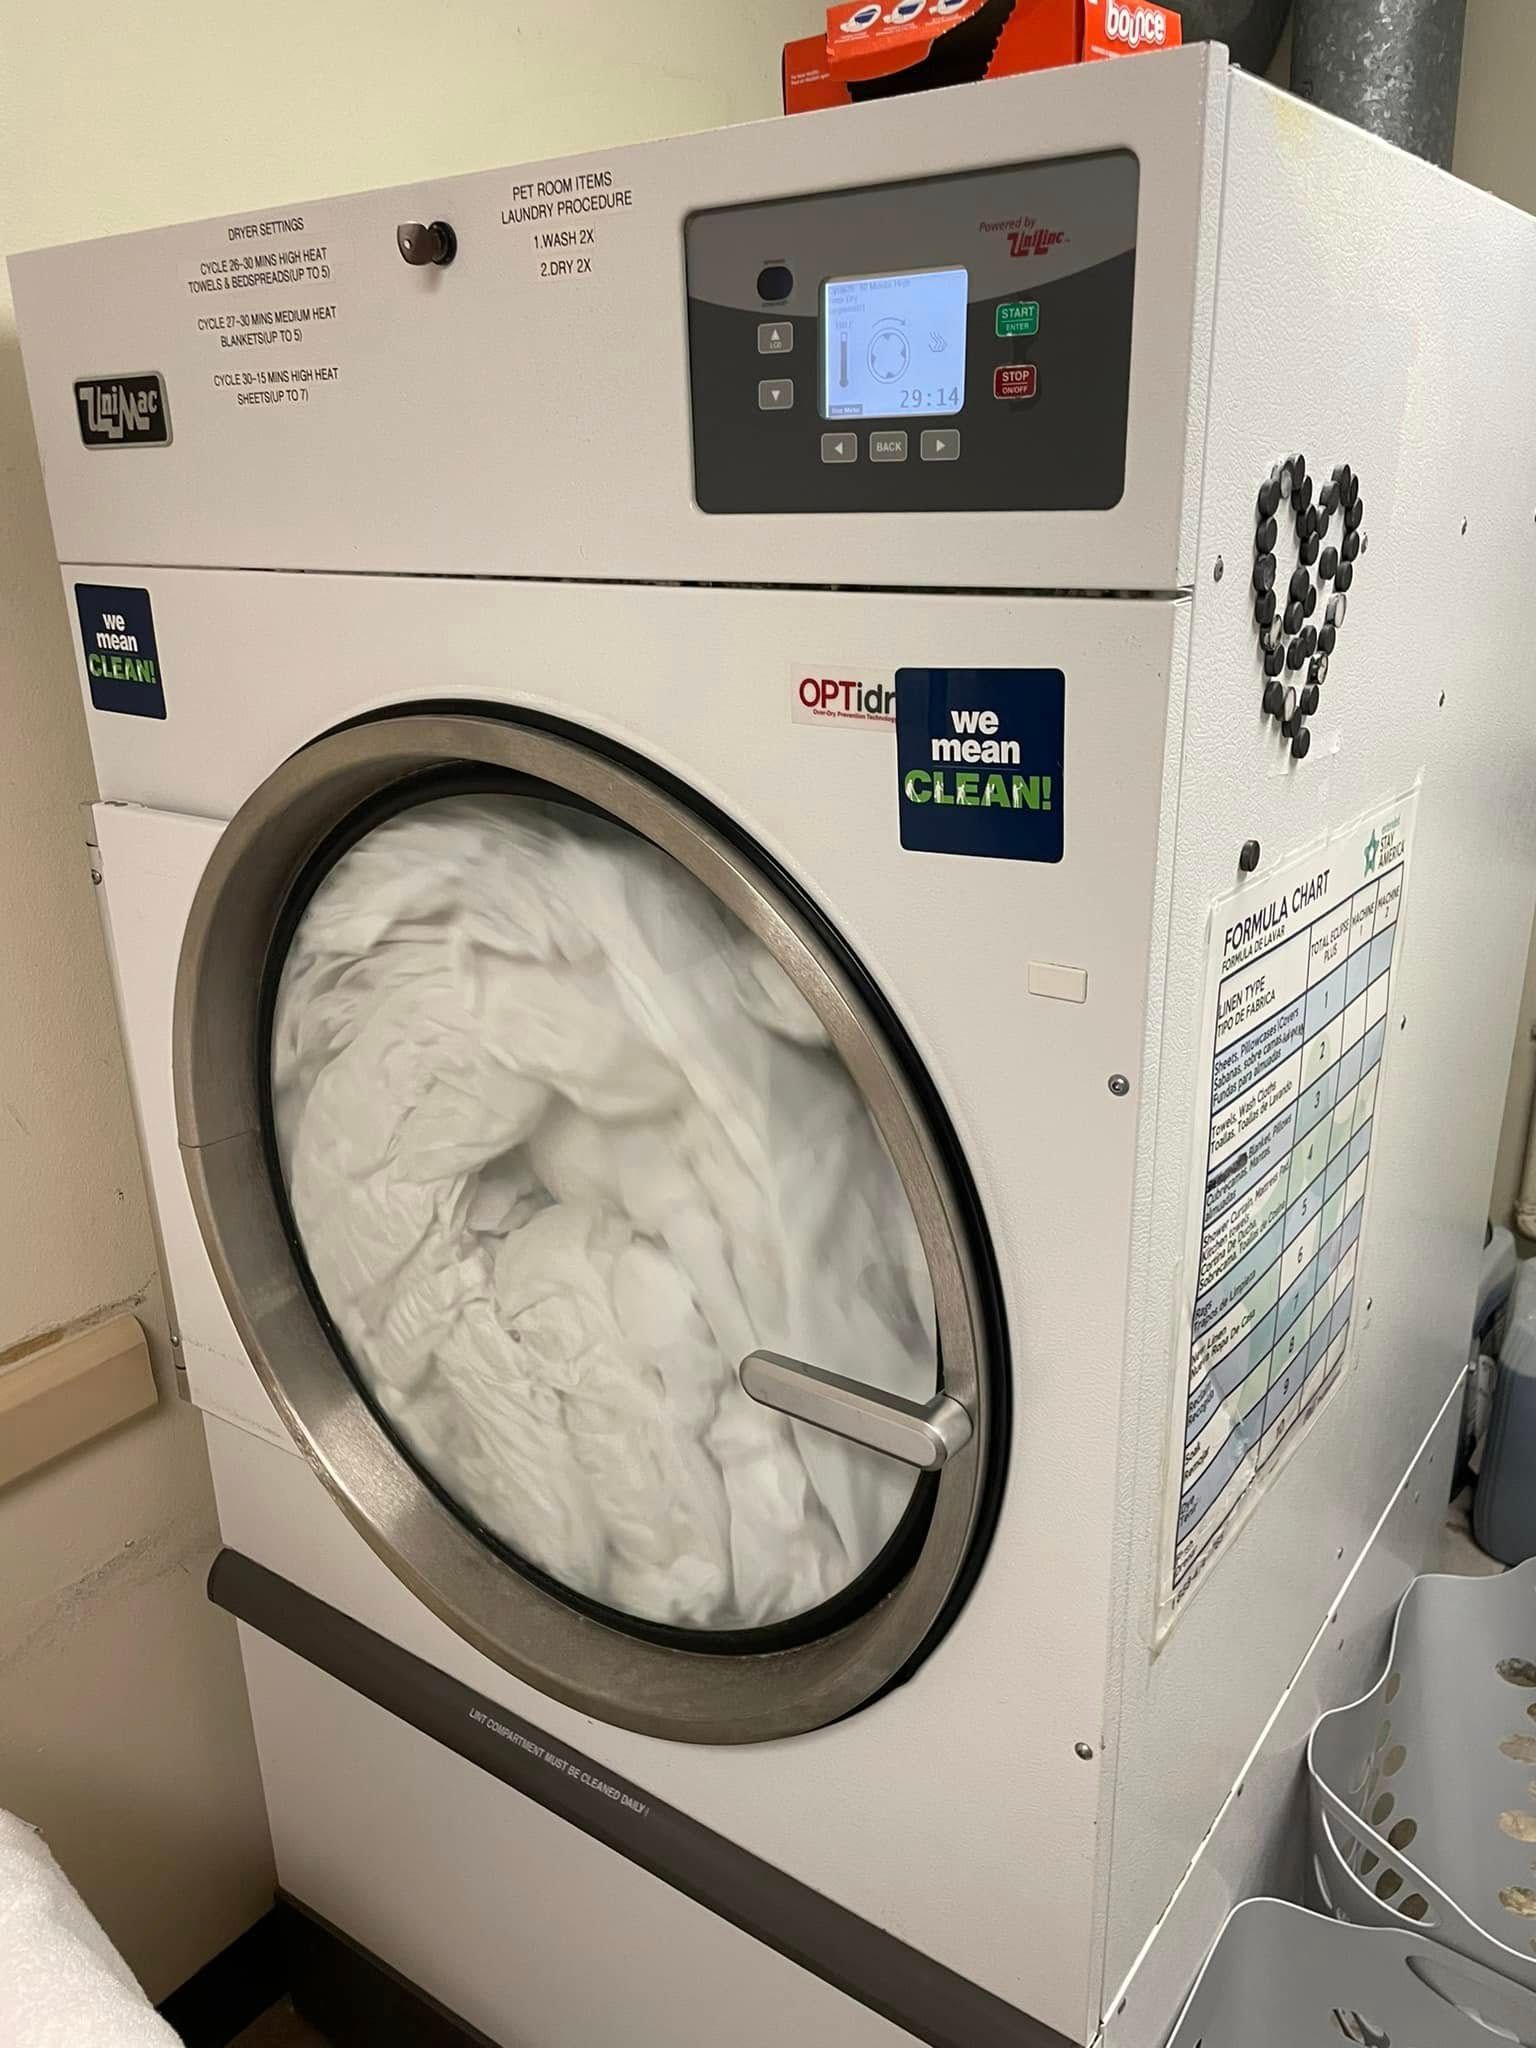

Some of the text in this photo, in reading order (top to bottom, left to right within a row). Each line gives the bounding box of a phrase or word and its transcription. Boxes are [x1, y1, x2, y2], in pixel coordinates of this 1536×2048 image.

[1106, 0, 1164, 45] bounce
[512, 171, 612, 201] PET ROOM ITEMS
[501, 190, 633, 225] LAUNDRY PROCEDURE
[228, 217, 305, 241] DRYER SETTINGS
[979, 215, 1037, 233] Powered by
[534, 229, 595, 249] 1.WASH 2X
[200, 247, 328, 276] CYCLE 26-30 MINS HIGH HEAT
[540, 258, 592, 277] 2.DRY 2X
[188, 278, 222, 294] TOWELS
[224, 277, 230, 289] &
[306, 266, 320, 280] TO
[321, 265, 331, 279] 5)
[197, 306, 337, 331] CYCLE 27-30 MINS MEDIUM HEAT
[1001, 306, 1035, 319] START
[279, 329, 292, 343] TO
[294, 328, 303, 342] 5)
[1006, 322, 1030, 332] ENTER
[213, 367, 339, 387] CYCLE 30-15 MINS HIGH HEAT
[1002, 370, 1030, 383] STOP
[286, 389, 299, 402] TO
[299, 388, 309, 402] 7)
[900, 387, 960, 409] 29:14
[79, 384, 158, 439] UniMac
[876, 441, 902, 452] BACK
[102, 613, 126, 632] we
[96, 632, 138, 652] mean
[88, 653, 157, 684] CLEAN!
[950, 710, 999, 735] we
[931, 738, 1021, 764] mean
[904, 769, 1052, 811] CLEAN!
[1380, 831, 1395, 852] STAY
[1378, 840, 1404, 869] AMERICA
[1223, 869, 1330, 956] FORMULA CHART
[1222, 925, 1285, 974] FORMULA DE LAVAR
[1312, 936, 1329, 957] TOTAL
[1324, 943, 1338, 963] PLUS
[1218, 975, 1266, 1020] LINEN TYPE
[1217, 989, 1276, 1038] TIPO DE FABRICA
[1241, 1025, 1277, 1058] Pillowcases
[1319, 1041, 1325, 1060] 2
[1239, 1096, 1256, 1117] Wash
[1314, 1090, 1321, 1109] 3
[1301, 1198, 1308, 1216] 5
[1297, 1246, 1303, 1264] 6
[1288, 1336, 1295, 1354] 8
[1283, 1378, 1290, 1395] 9
[468, 1707, 488, 1725] LINT
[486, 1718, 545, 1759] COMPARTMENT
[544, 1752, 570, 1772] MUST
[567, 1764, 581, 1779] BE
[580, 1772, 621, 1801] CLEANED
[620, 1793, 647, 1816] DAILY
